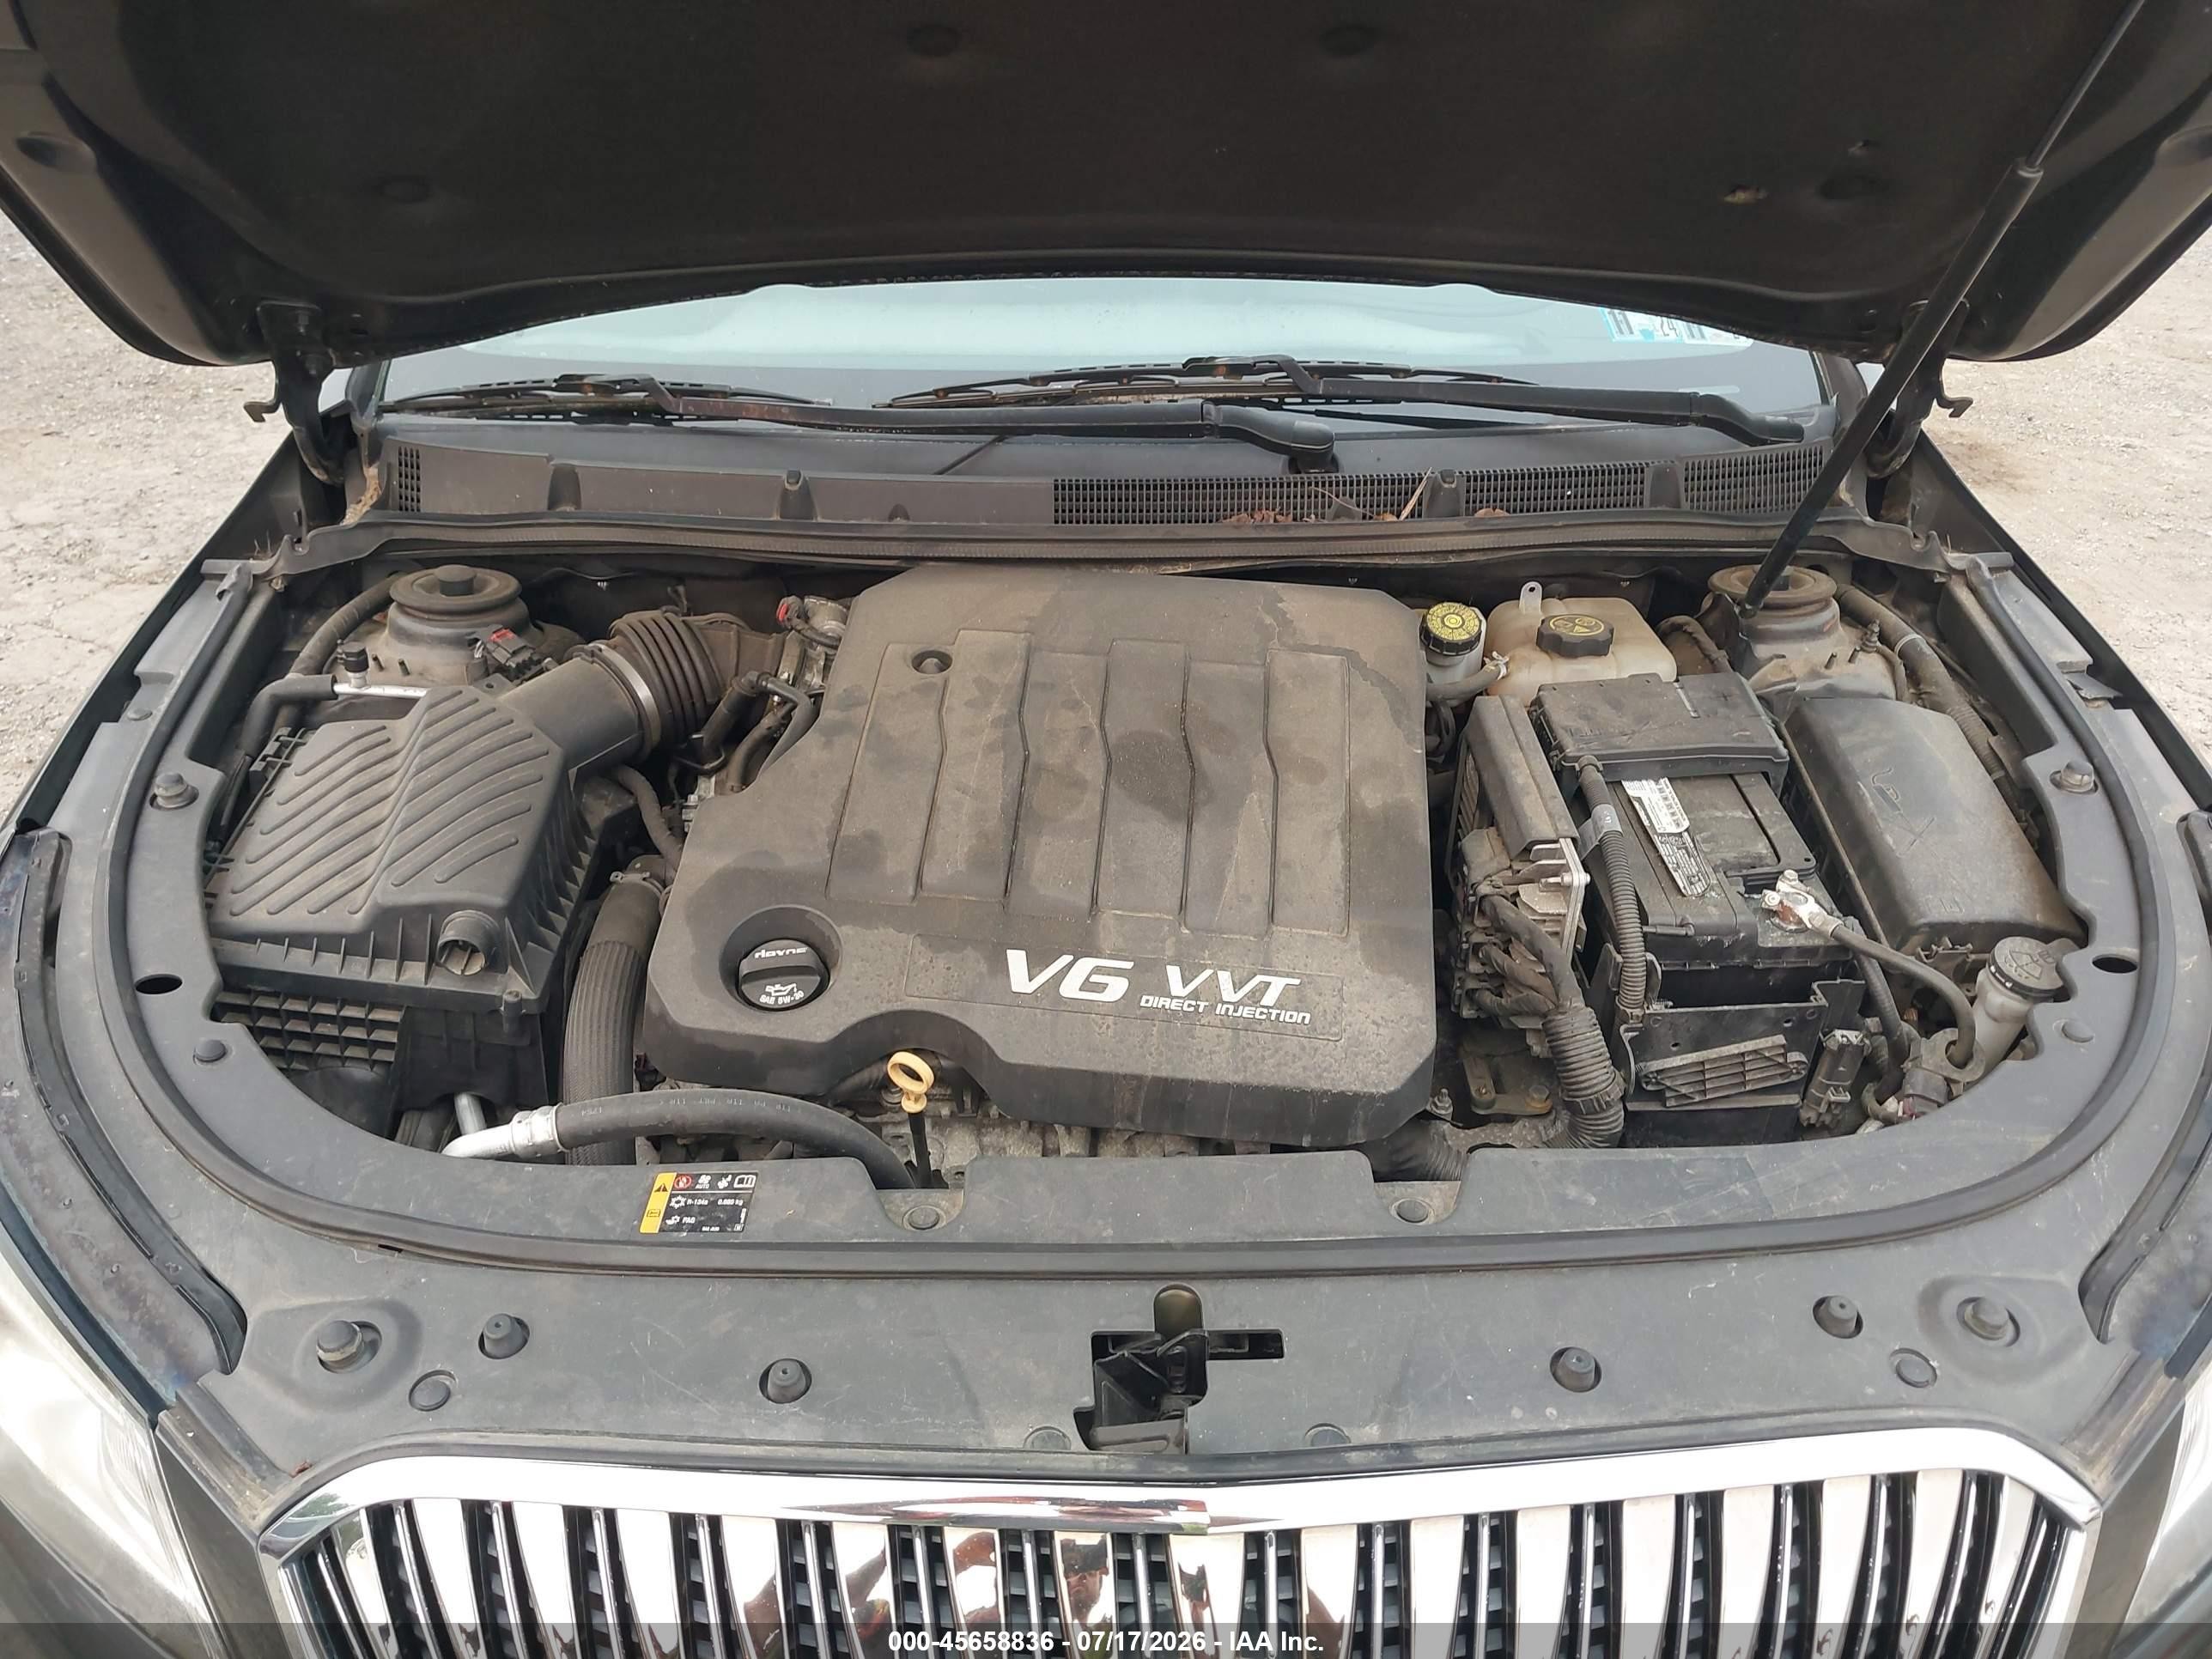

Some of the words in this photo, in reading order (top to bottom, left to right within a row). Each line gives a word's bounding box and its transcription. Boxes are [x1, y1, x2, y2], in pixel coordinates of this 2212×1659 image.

[1006, 949, 1134, 1002] V6
[1165, 964, 1302, 1007] VVT
[760, 994, 775, 1004] SAE
[1140, 994, 1209, 1013] DIRECT
[1215, 1003, 1311, 1025] INJECTION
